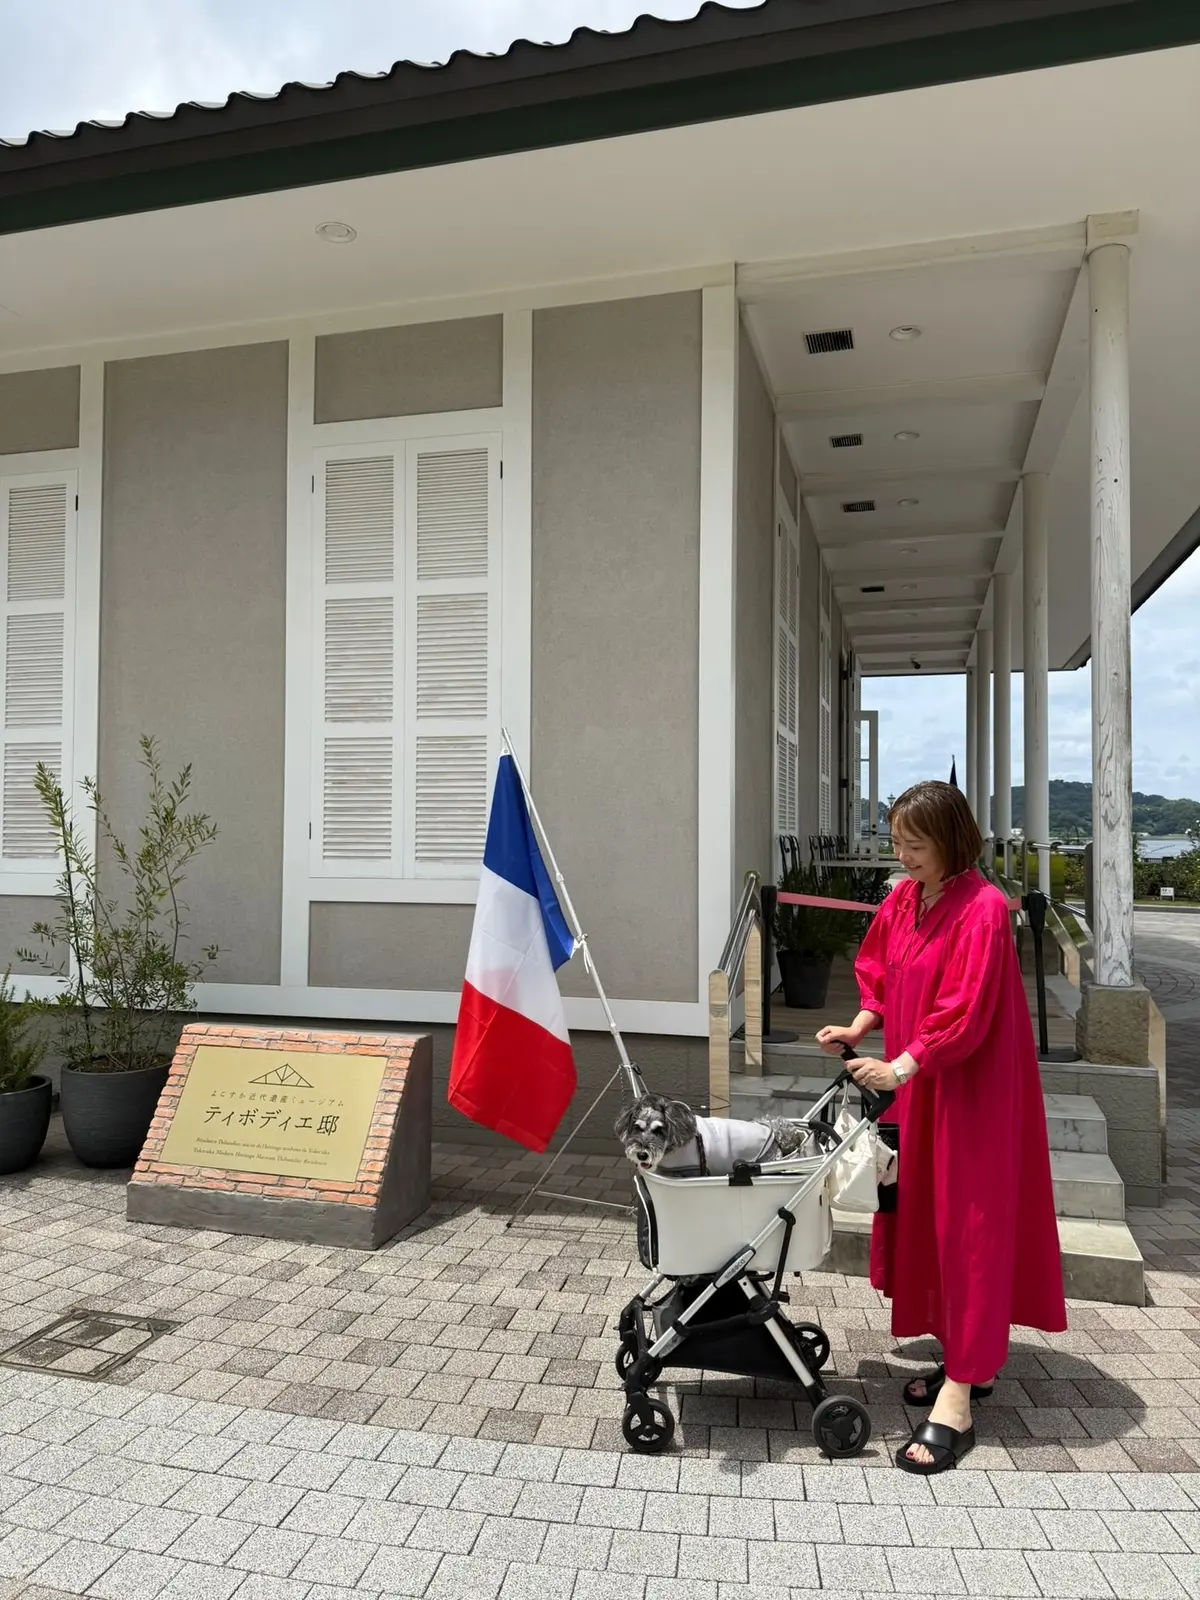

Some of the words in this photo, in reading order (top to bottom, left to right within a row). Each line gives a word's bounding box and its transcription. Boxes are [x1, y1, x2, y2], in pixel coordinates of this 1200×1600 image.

[211, 1090, 344, 1106] よこすか近代遺産ミュージアム
[204, 1106, 340, 1136] ティボディエ邸
